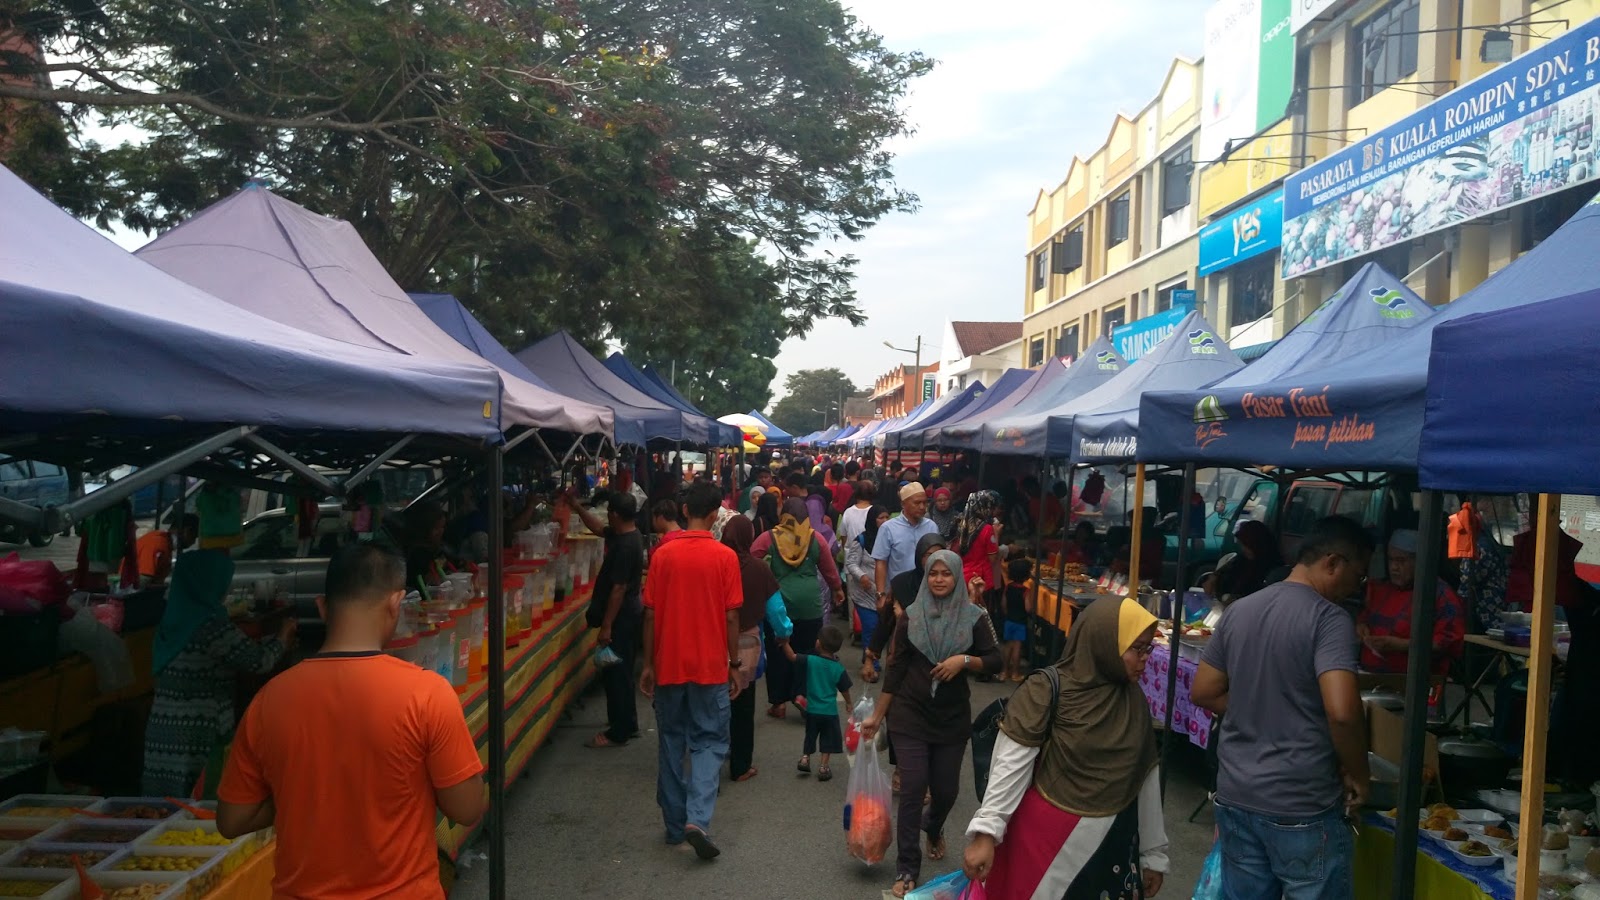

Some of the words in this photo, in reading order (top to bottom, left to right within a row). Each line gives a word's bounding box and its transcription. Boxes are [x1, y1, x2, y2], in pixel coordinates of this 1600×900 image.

[1263, 16, 1290, 43] oppo
[1300, 158, 1354, 200] PASARAYA
[1361, 137, 1385, 172] BS
[1389, 117, 1438, 158] KUALA
[1444, 76, 1517, 132] ROMPIN
[1525, 49, 1574, 93] SDN.
[1584, 36, 1600, 66] B
[1312, 183, 1346, 206] MEMBORONG
[1346, 178, 1360, 191] DAN
[1360, 168, 1387, 185] MENJUAL
[1387, 150, 1426, 173] BARANGAN
[1426, 124, 1472, 155] KEPERLUAN
[1473, 110, 1505, 134] HARIAN
[1232, 207, 1261, 257] yes
[1241, 392, 1287, 418] Pasar
[1288, 385, 1333, 417] Tani
[1290, 421, 1326, 450] pasar
[1325, 413, 1375, 450] pilihan
